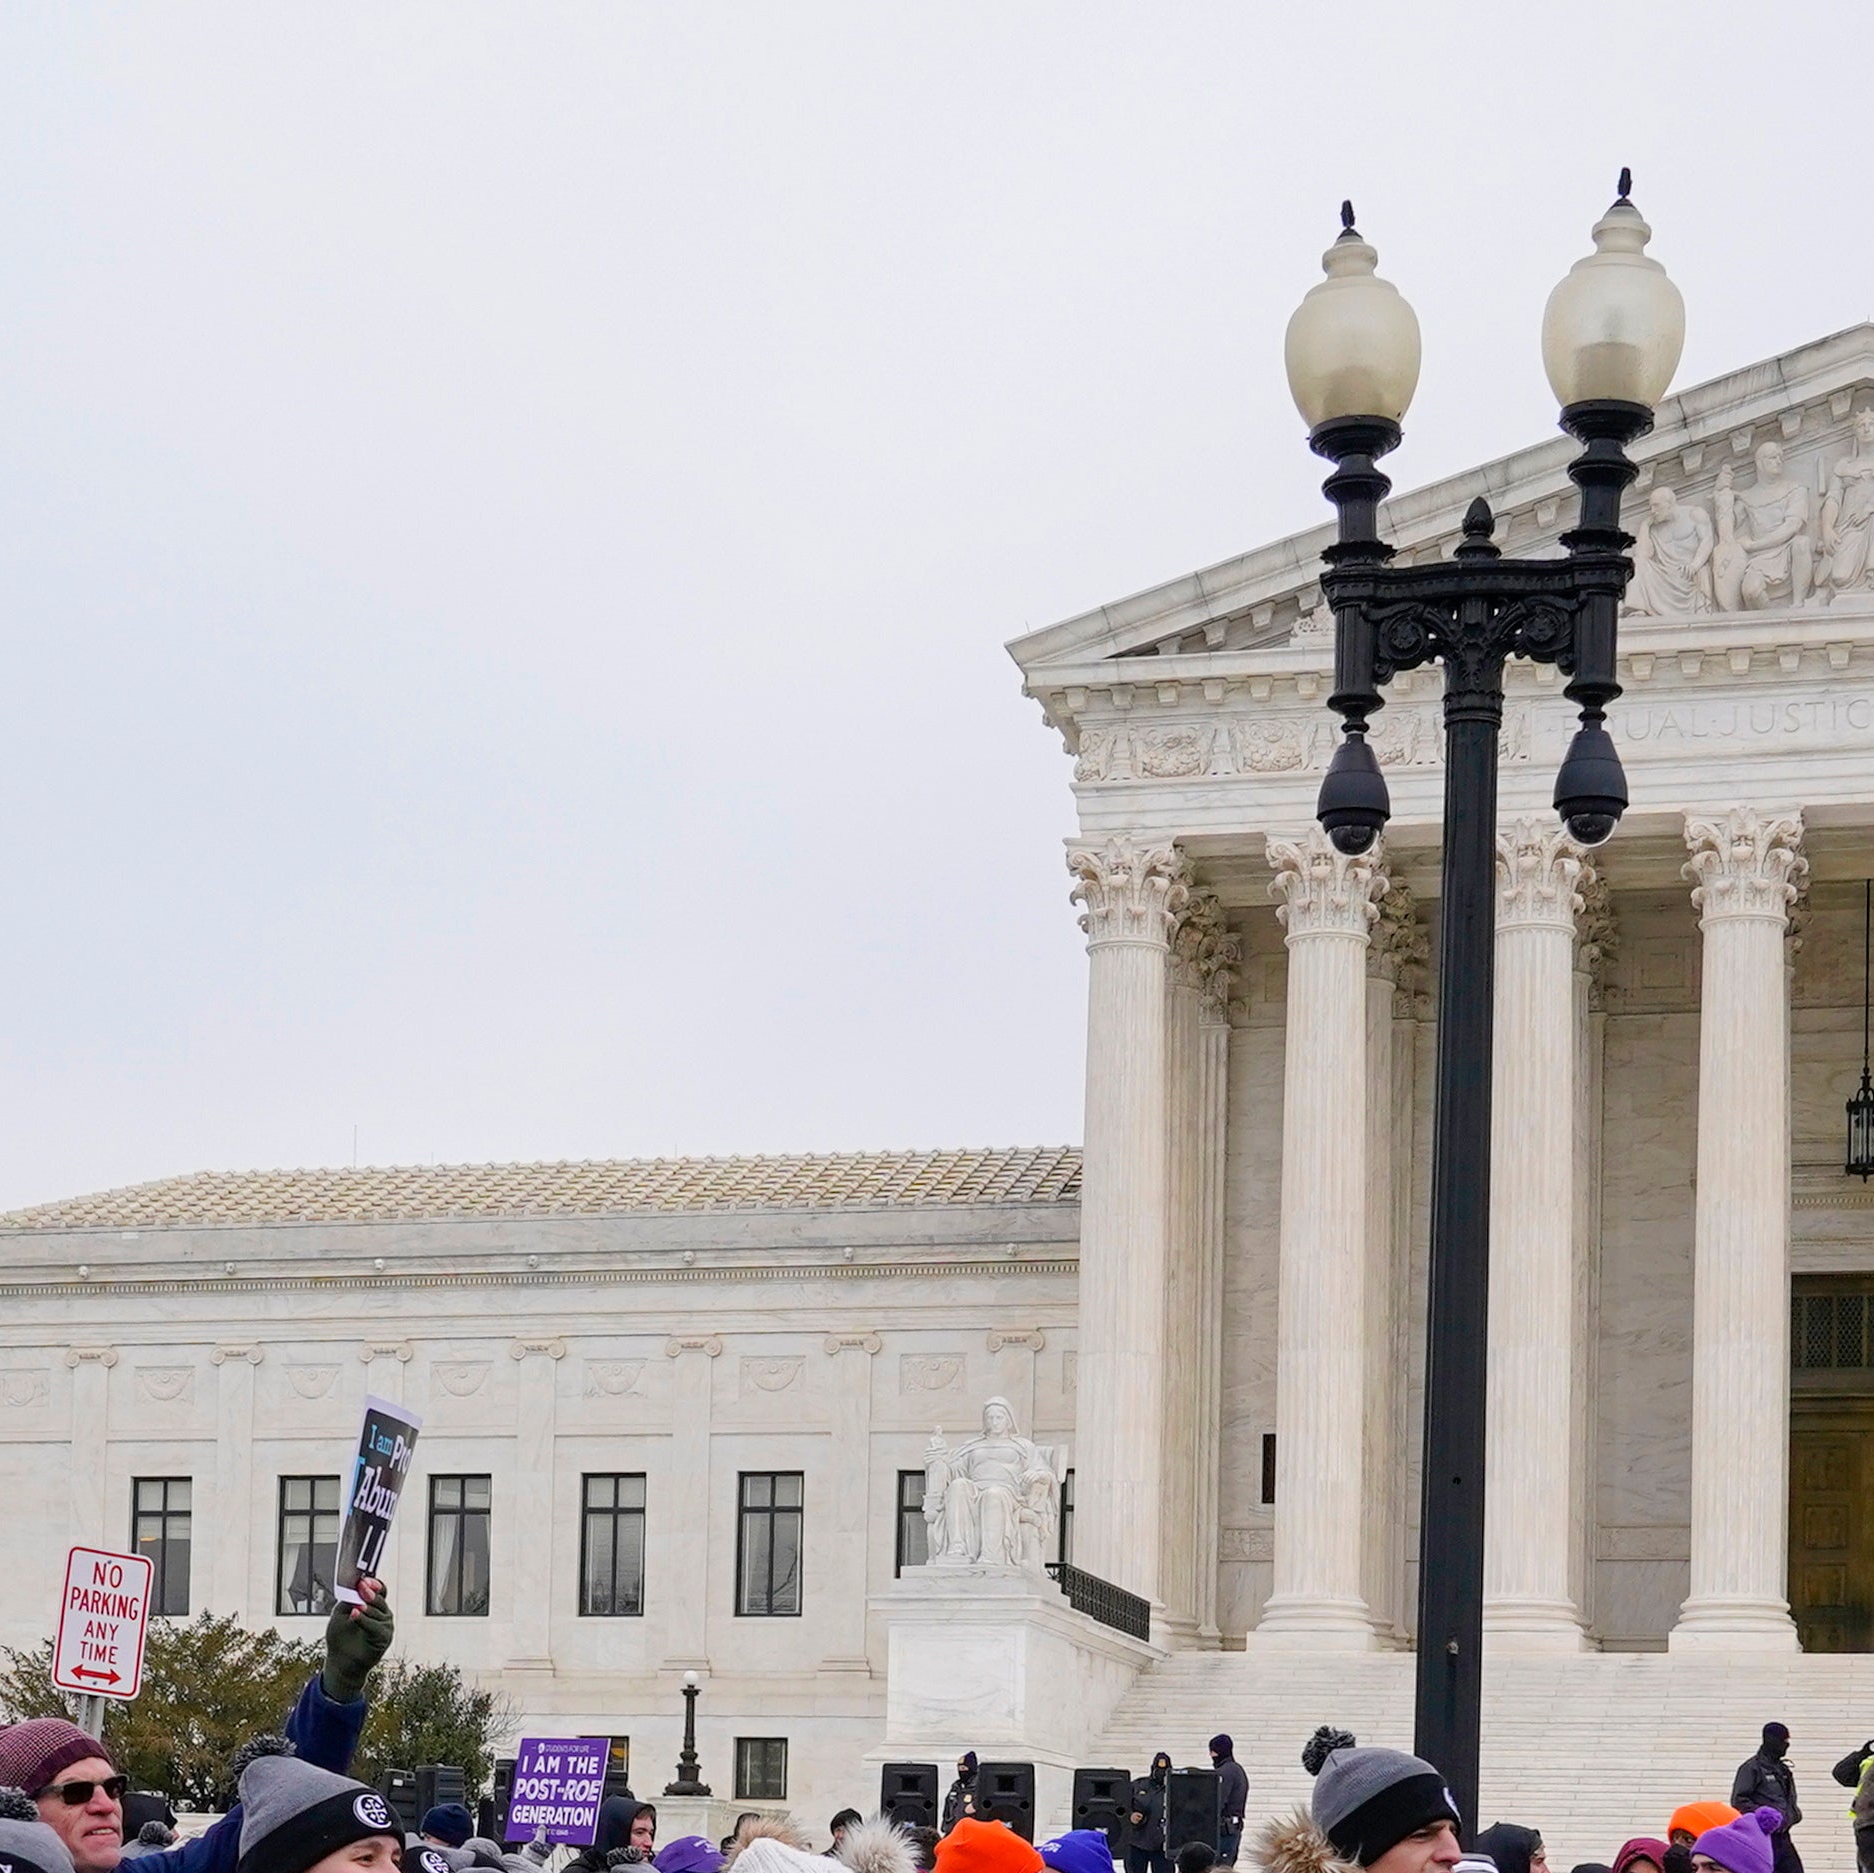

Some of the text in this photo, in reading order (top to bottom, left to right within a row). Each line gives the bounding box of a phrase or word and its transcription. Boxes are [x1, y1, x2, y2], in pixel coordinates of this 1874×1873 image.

[1562, 707, 1708, 747] EUAL
[368, 1424, 378, 1449] I
[376, 1436, 394, 1456] am
[93, 1561, 123, 1588] NO
[69, 1586, 139, 1621] PARKING
[83, 1620, 119, 1641] ANY
[80, 1640, 119, 1665] TIME
[522, 1755, 599, 1774] I AM THE
[513, 1778, 602, 1802] POST-ROE
[511, 1804, 595, 1827] GENERATION
